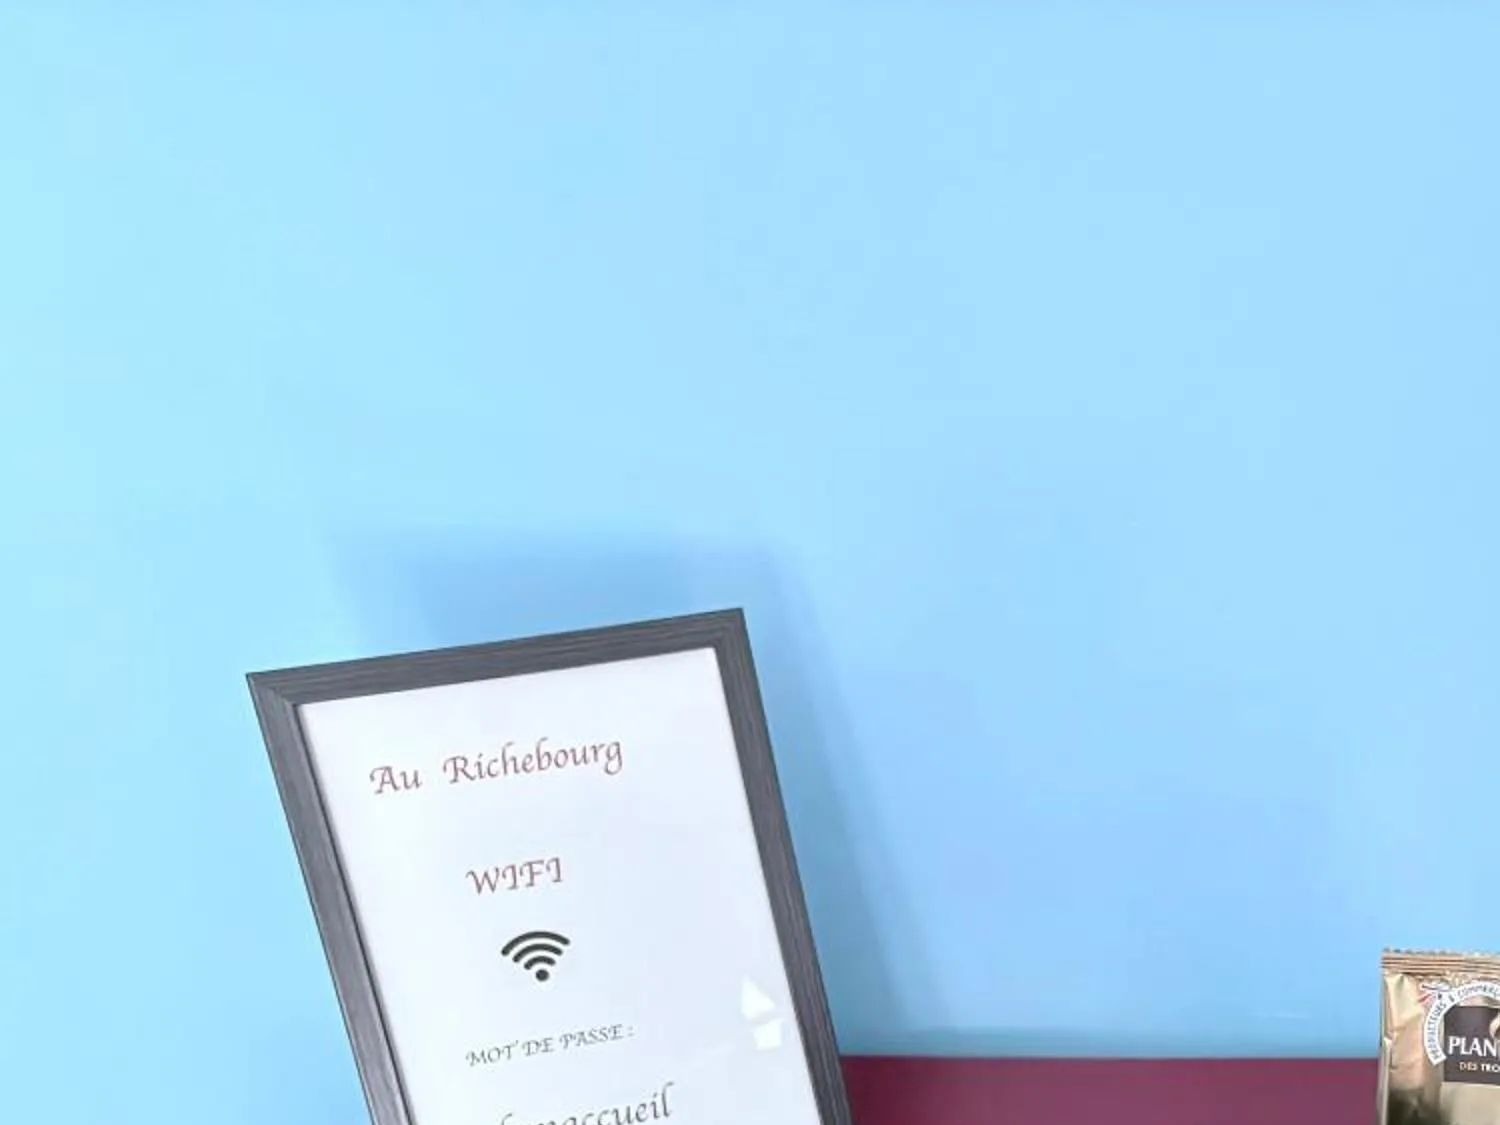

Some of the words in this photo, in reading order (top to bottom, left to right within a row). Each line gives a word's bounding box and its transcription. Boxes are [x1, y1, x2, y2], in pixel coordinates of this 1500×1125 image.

[368, 765, 422, 795] Au
[442, 737, 624, 785] Richebourg
[465, 857, 563, 895] WIFI
[465, 1040, 519, 1067] MOT
[521, 1037, 554, 1057] DE
